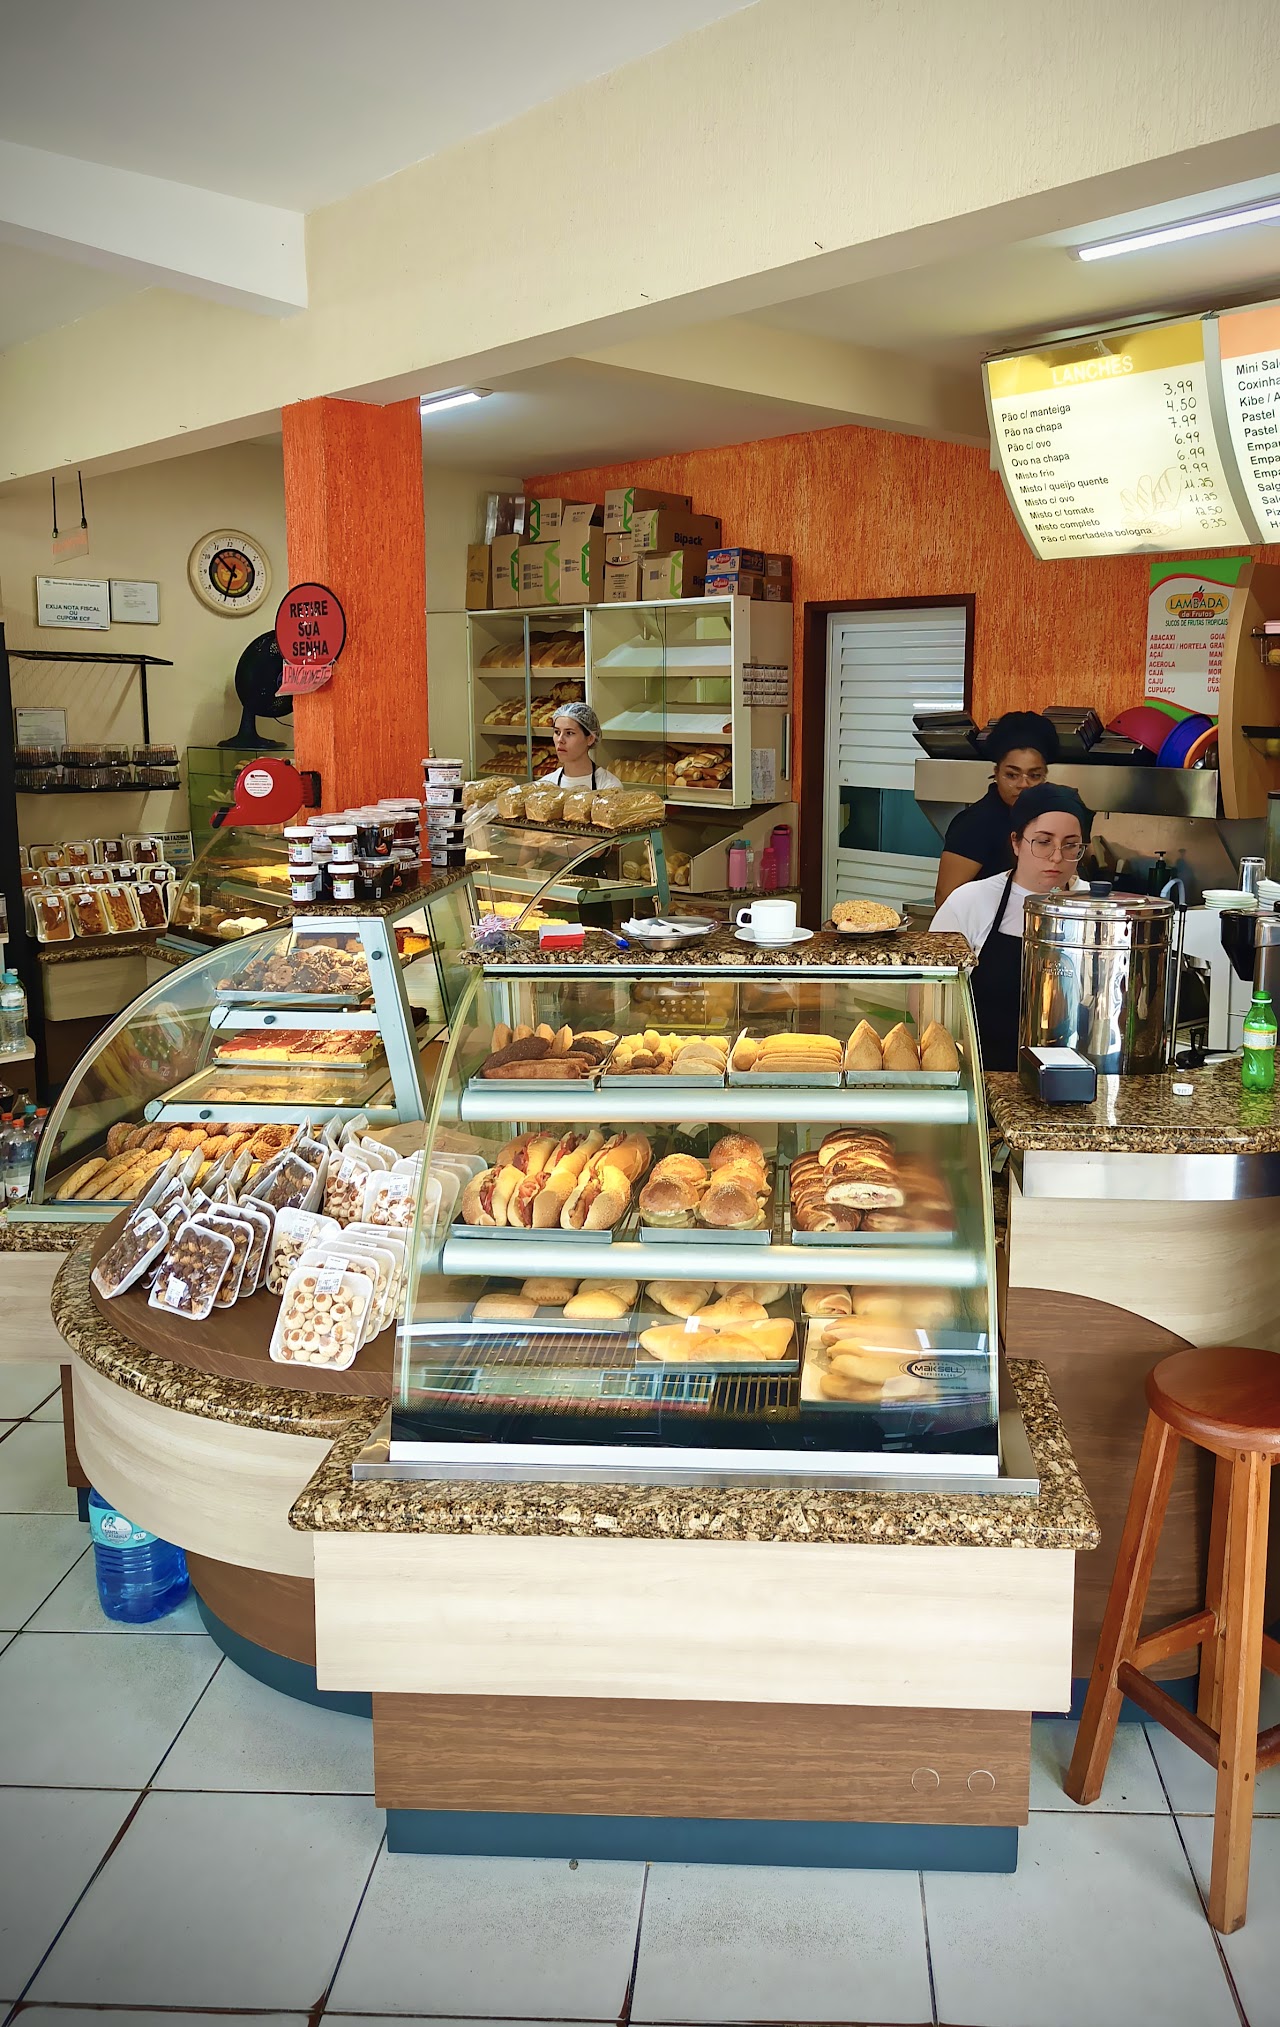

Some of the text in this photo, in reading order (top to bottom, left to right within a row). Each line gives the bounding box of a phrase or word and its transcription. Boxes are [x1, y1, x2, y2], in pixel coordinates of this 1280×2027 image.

[1052, 355, 1134, 385] LANCHES
[1236, 361, 1258, 376] Mini
[1240, 395, 1264, 407] Kibe
[1002, 404, 1071, 422] Pão c/ manteiga
[1242, 408, 1275, 422] Pastel
[1004, 422, 1063, 437] Pão na chapa
[1244, 424, 1278, 437] Pastel
[1174, 431, 1200, 445] 6.99
[1007, 440, 1051, 452] Pão c/ ovo
[1011, 452, 1070, 467] Ovo na chapa
[1177, 446, 1205, 461] 6.99
[1015, 469, 1055, 480] Misto frio
[1179, 462, 1209, 474] 9.99
[1019, 485, 1043, 493] Misto
[1049, 480, 1076, 492] queijo
[1077, 476, 1109, 488] quente
[1024, 495, 1075, 507] Misto c/ ovo
[1029, 506, 1095, 520] Misto c/ tomate
[1035, 519, 1100, 532] Misto completo
[674, 532, 703, 547] Bipack
[1040, 527, 1152, 543] Pão c/ mortadela bologna
[290, 600, 328, 618] RETIRE
[1170, 597, 1224, 609] LAMBADA
[298, 621, 320, 637] SUA
[1180, 619, 1187, 627] DE
[1205, 618, 1229, 626] TROPICAIS
[292, 640, 329, 657] SENHA
[284, 666, 331, 684] LANCHONETE
[1148, 687, 1176, 695] CUPUAÇU
